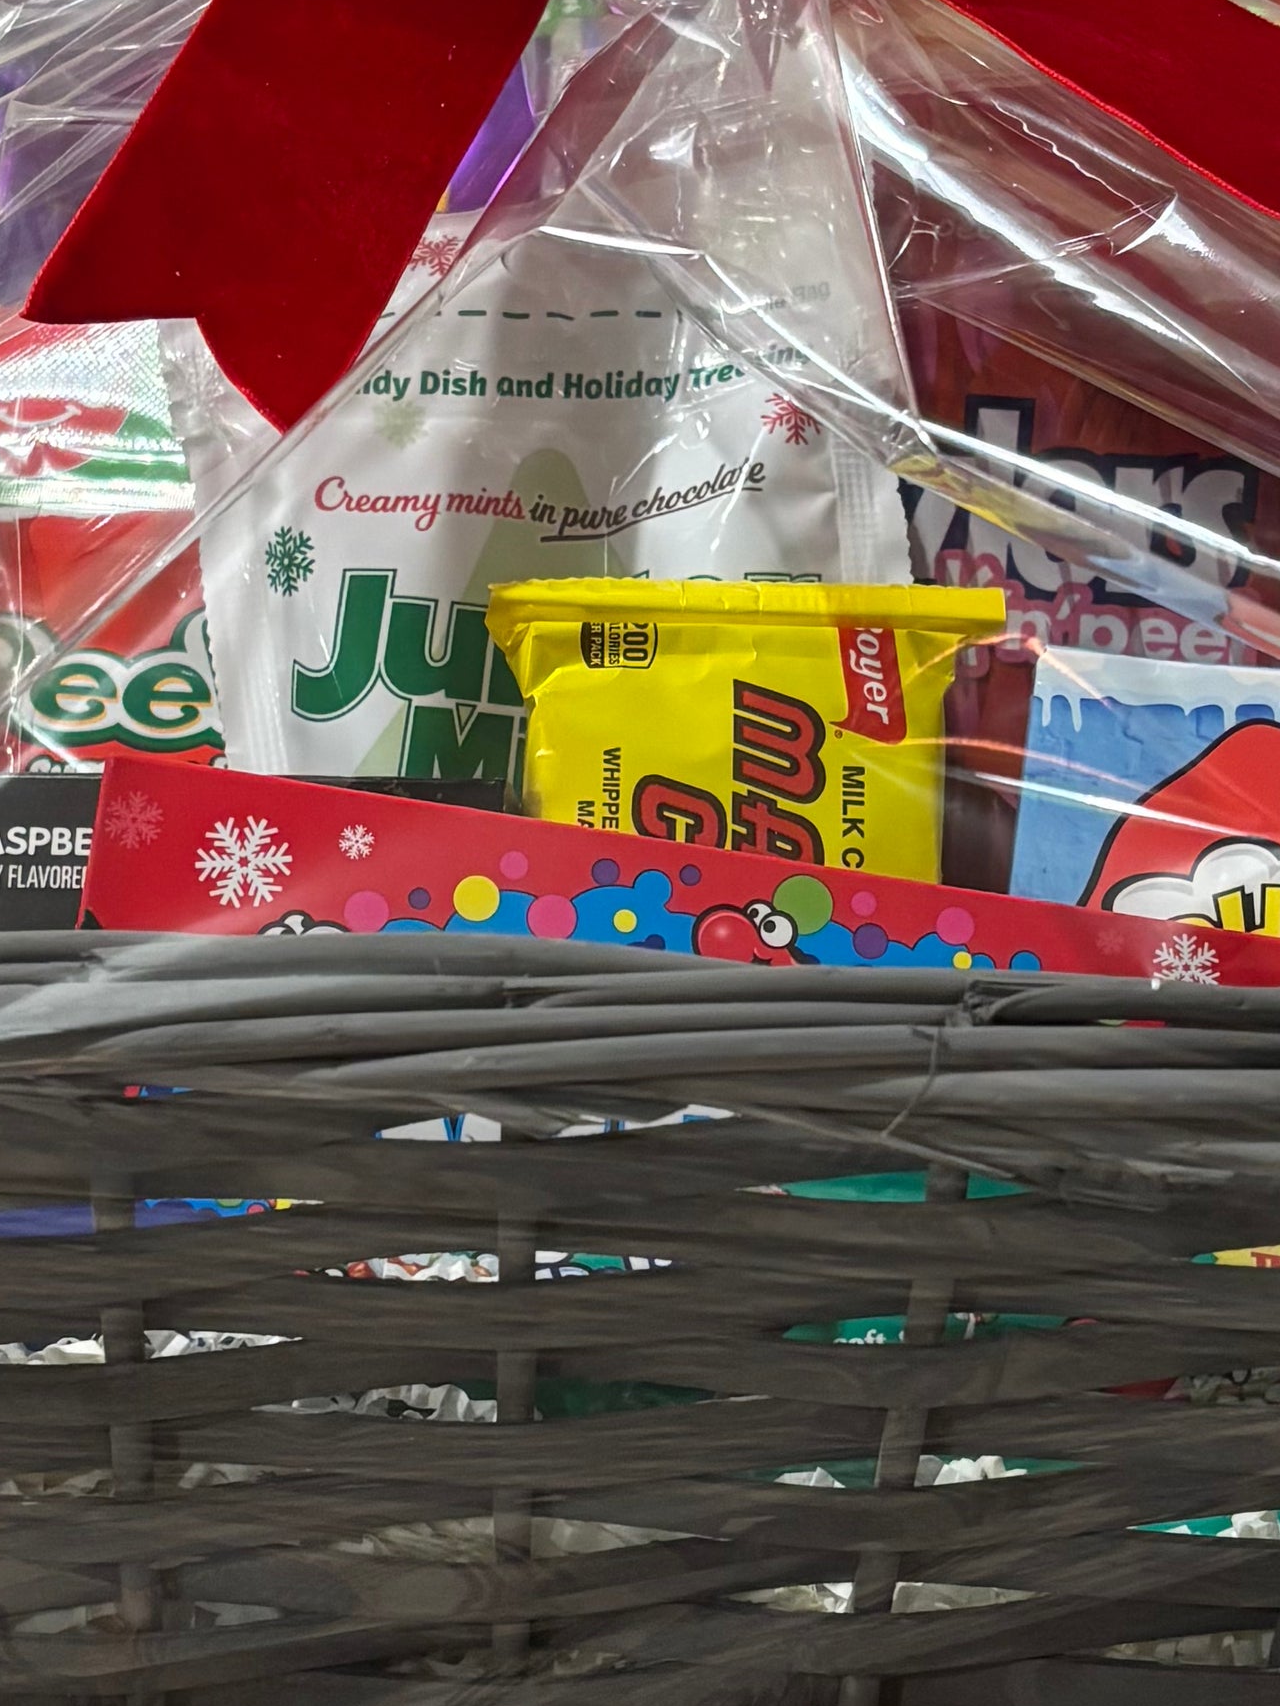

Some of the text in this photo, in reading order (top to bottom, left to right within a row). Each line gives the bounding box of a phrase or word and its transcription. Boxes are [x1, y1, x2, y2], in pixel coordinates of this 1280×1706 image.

[419, 370, 487, 398] Dish
[496, 372, 555, 400] and
[562, 370, 681, 404] Holiday
[313, 458, 767, 537] Creamy mints in pure chocolate
[590, 637, 602, 666] PACK
[602, 747, 622, 831] WHIPPE
[841, 765, 866, 839] MILK
